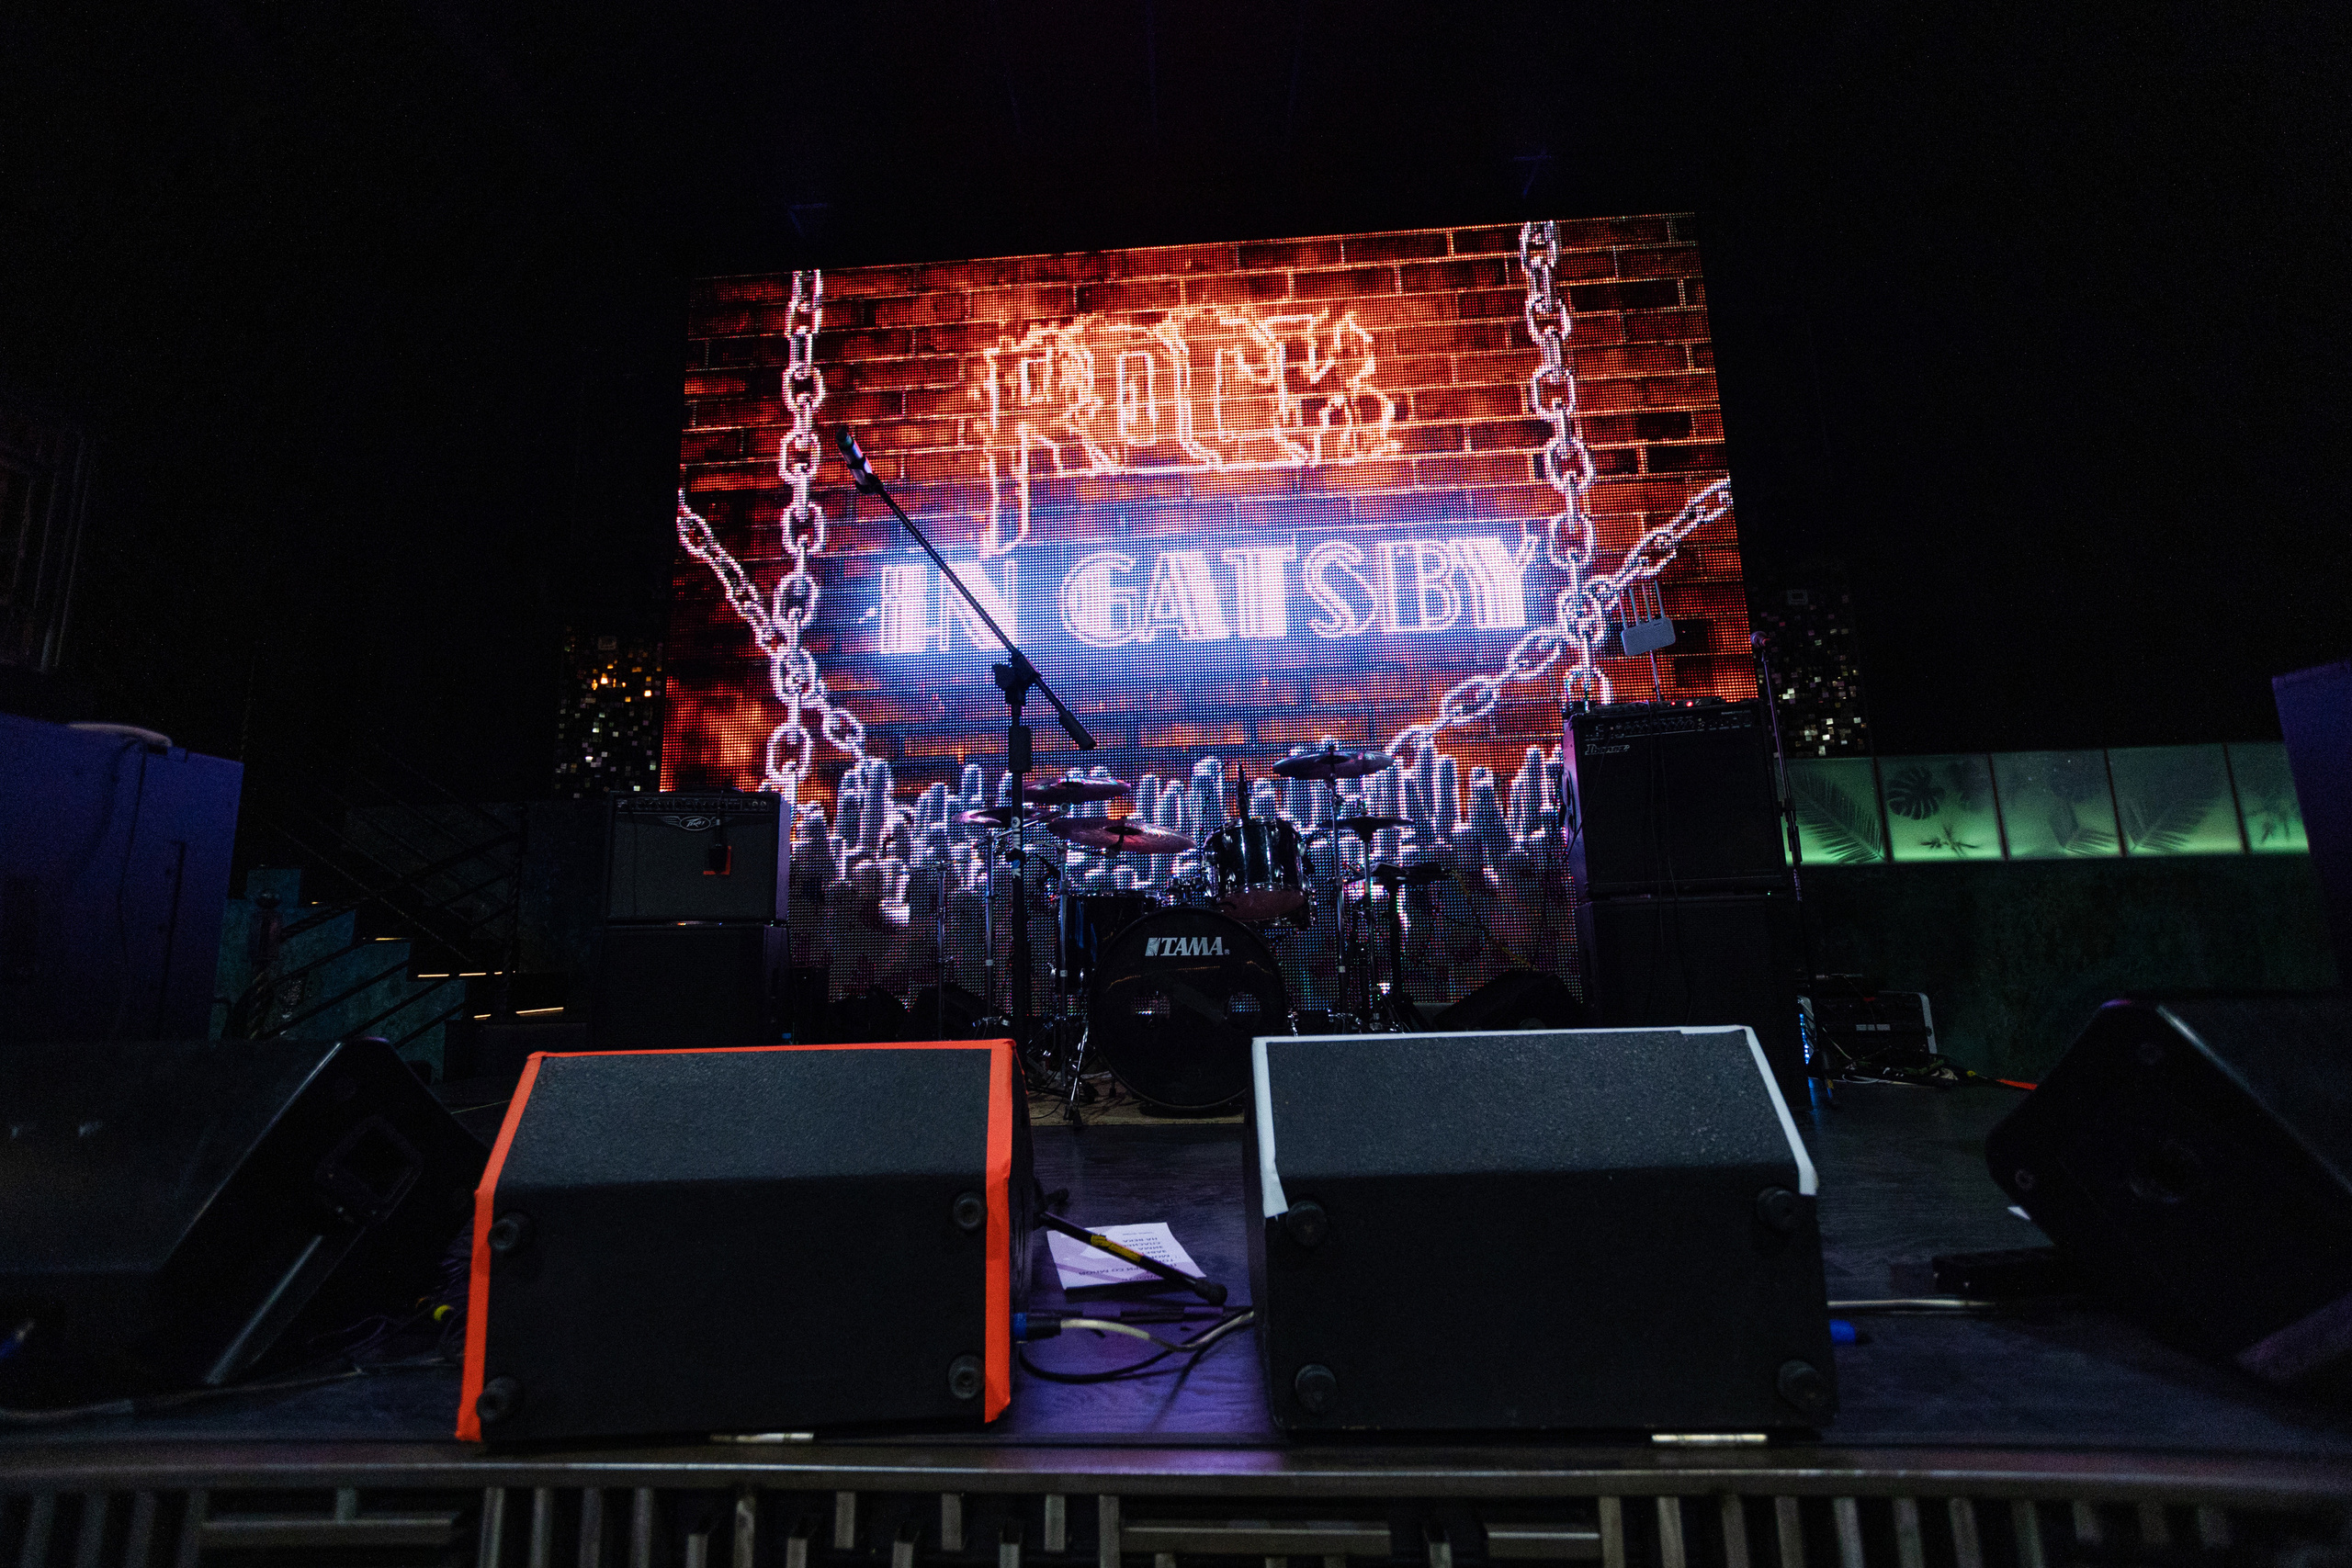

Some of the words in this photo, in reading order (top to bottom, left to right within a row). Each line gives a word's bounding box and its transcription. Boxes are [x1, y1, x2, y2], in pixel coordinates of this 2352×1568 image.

[978, 305, 1401, 557] ROCK
[879, 558, 1018, 654] IN
[1058, 533, 1540, 648] GATSBY
[1159, 936, 1225, 956] TAMA
